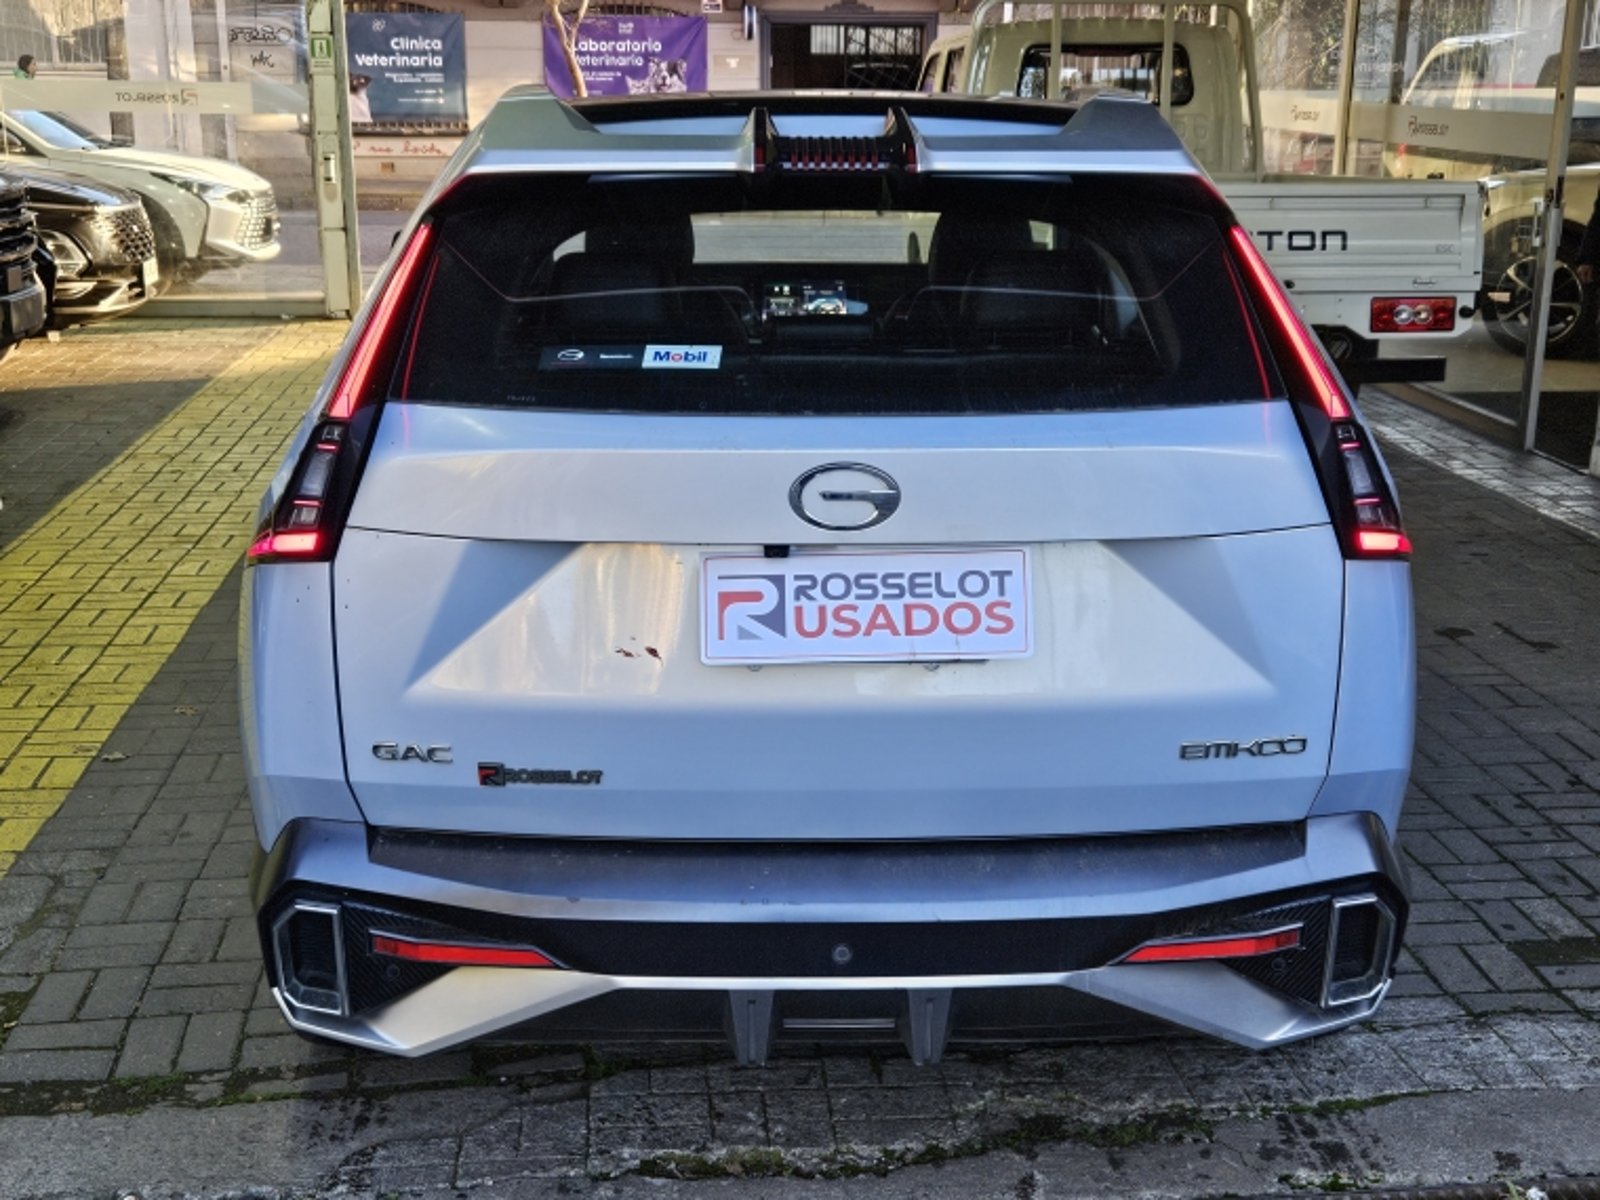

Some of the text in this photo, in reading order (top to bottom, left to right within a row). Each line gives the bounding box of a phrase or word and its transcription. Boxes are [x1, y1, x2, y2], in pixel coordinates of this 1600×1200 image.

[355, 52, 443, 67] Veterinaria
[653, 350, 708, 363] Mobil
[793, 570, 1013, 601] ROSSELOT
[794, 600, 1015, 639] USADOS
[372, 742, 454, 763] GAC
